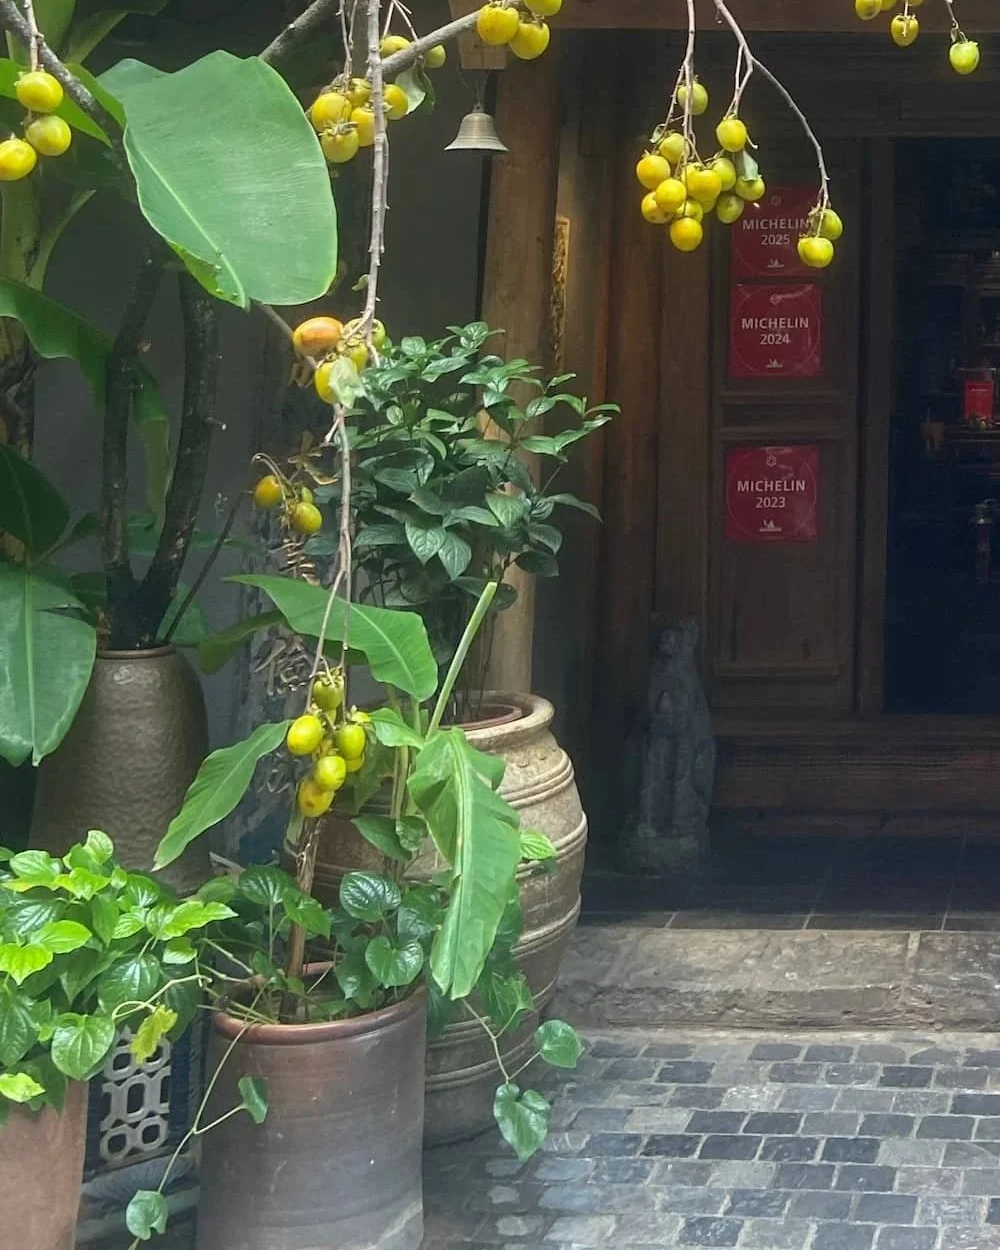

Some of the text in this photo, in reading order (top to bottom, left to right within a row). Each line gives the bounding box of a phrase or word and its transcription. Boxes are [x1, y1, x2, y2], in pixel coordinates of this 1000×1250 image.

[742, 218, 811, 231] MICHELIN
[760, 234, 791, 246] 2025
[741, 317, 810, 330] MICHELIN
[759, 334, 790, 346] 2024
[737, 480, 806, 493] MICHELIN
[755, 496, 786, 509] 2023
